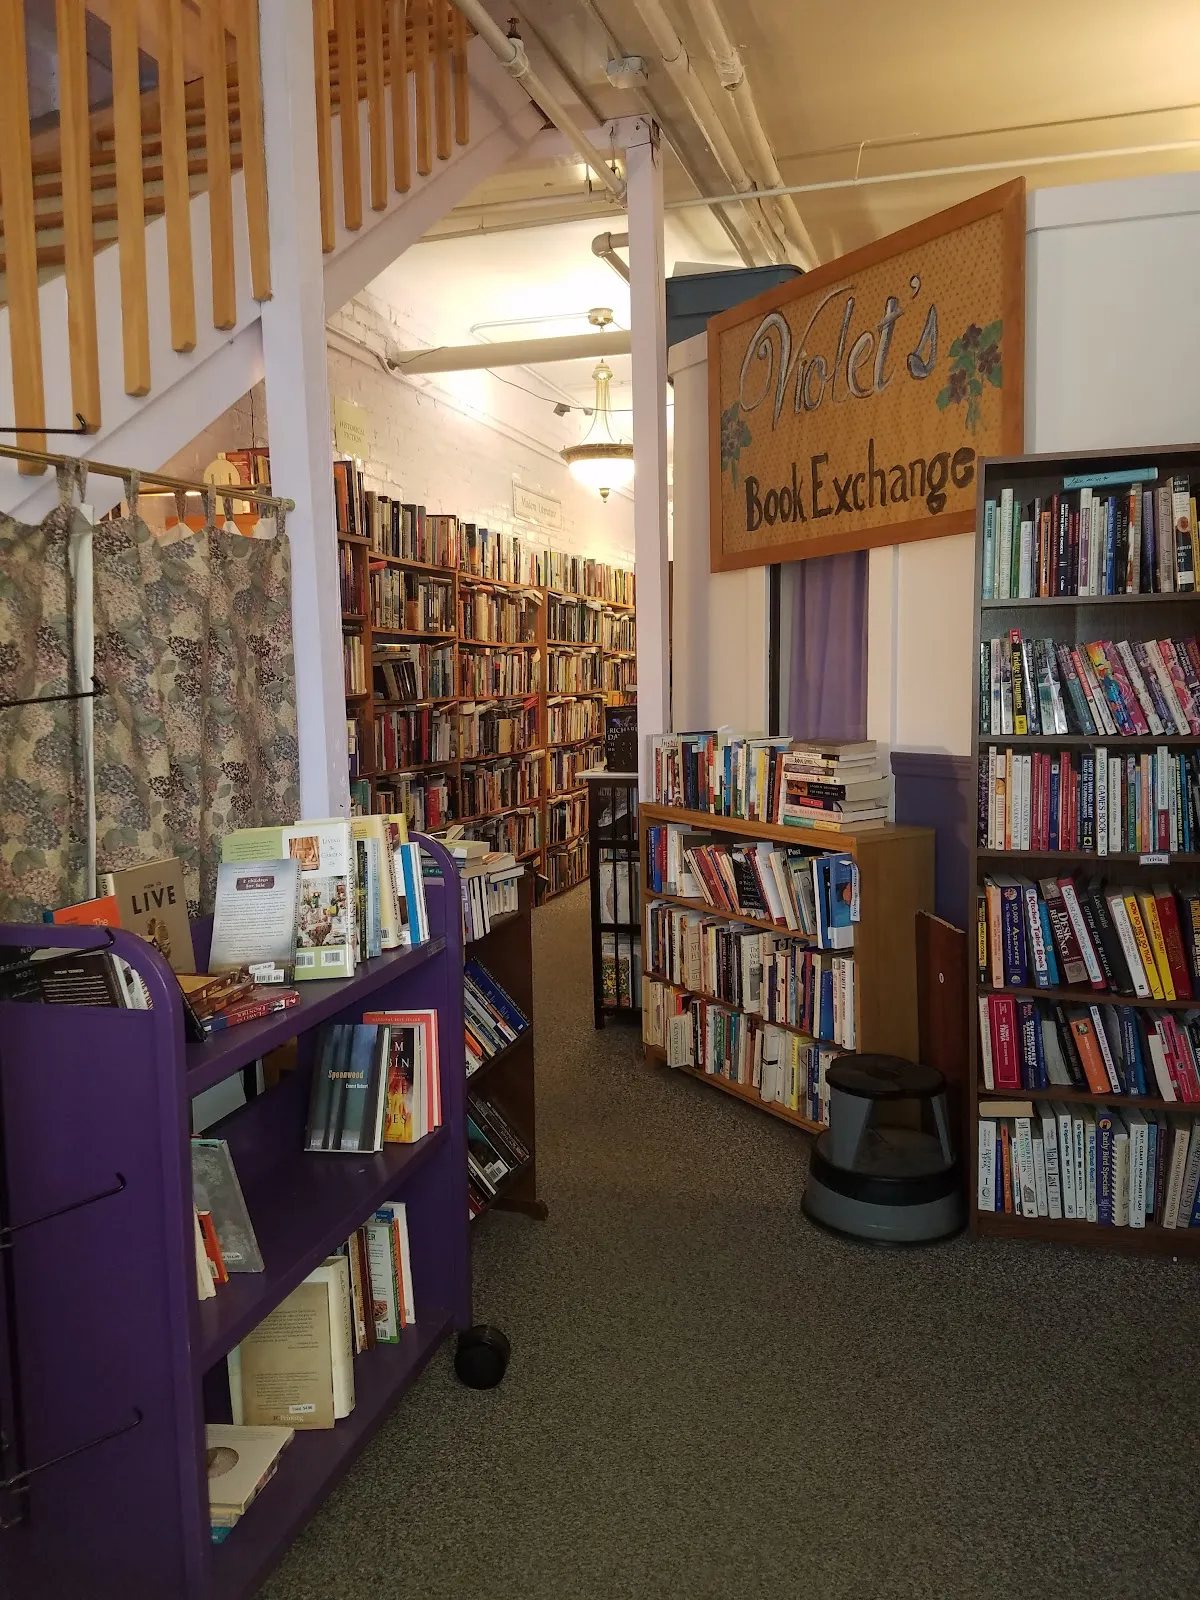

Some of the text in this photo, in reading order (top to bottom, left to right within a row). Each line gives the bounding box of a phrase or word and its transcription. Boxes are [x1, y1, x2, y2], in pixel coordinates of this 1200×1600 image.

[739, 274, 939, 431] Violet's
[343, 430, 362, 443] FICTION
[744, 438, 976, 532] Book Exchange
[1012, 652, 1023, 709] Bridge Dummies
[1098, 785, 1106, 834] GAMES BOOK
[92, 917, 109, 926] The
[131, 885, 177, 915] LIVE
[1011, 903, 1020, 966] 10,000 Answers
[1028, 896, 1045, 969] Kitchen Table Book
[1050, 909, 1069, 957] REFERENCE
[1058, 912, 1073, 941] DESK
[1085, 906, 1112, 978] CUTTING EDGE BLACKJACK
[1130, 901, 1152, 965] HOW DO THEY DO THAT?
[1152, 914, 1158, 922] DO
[1156, 933, 1162, 941] DO
[1029, 1020, 1038, 1067] SUPREMELY
[327, 1069, 364, 1080] Spoonwood
[1046, 1148, 1059, 1187] Make Last
[1100, 1131, 1110, 1196] Early Bird Specials
[1188, 1160, 1199, 1184] HOME
